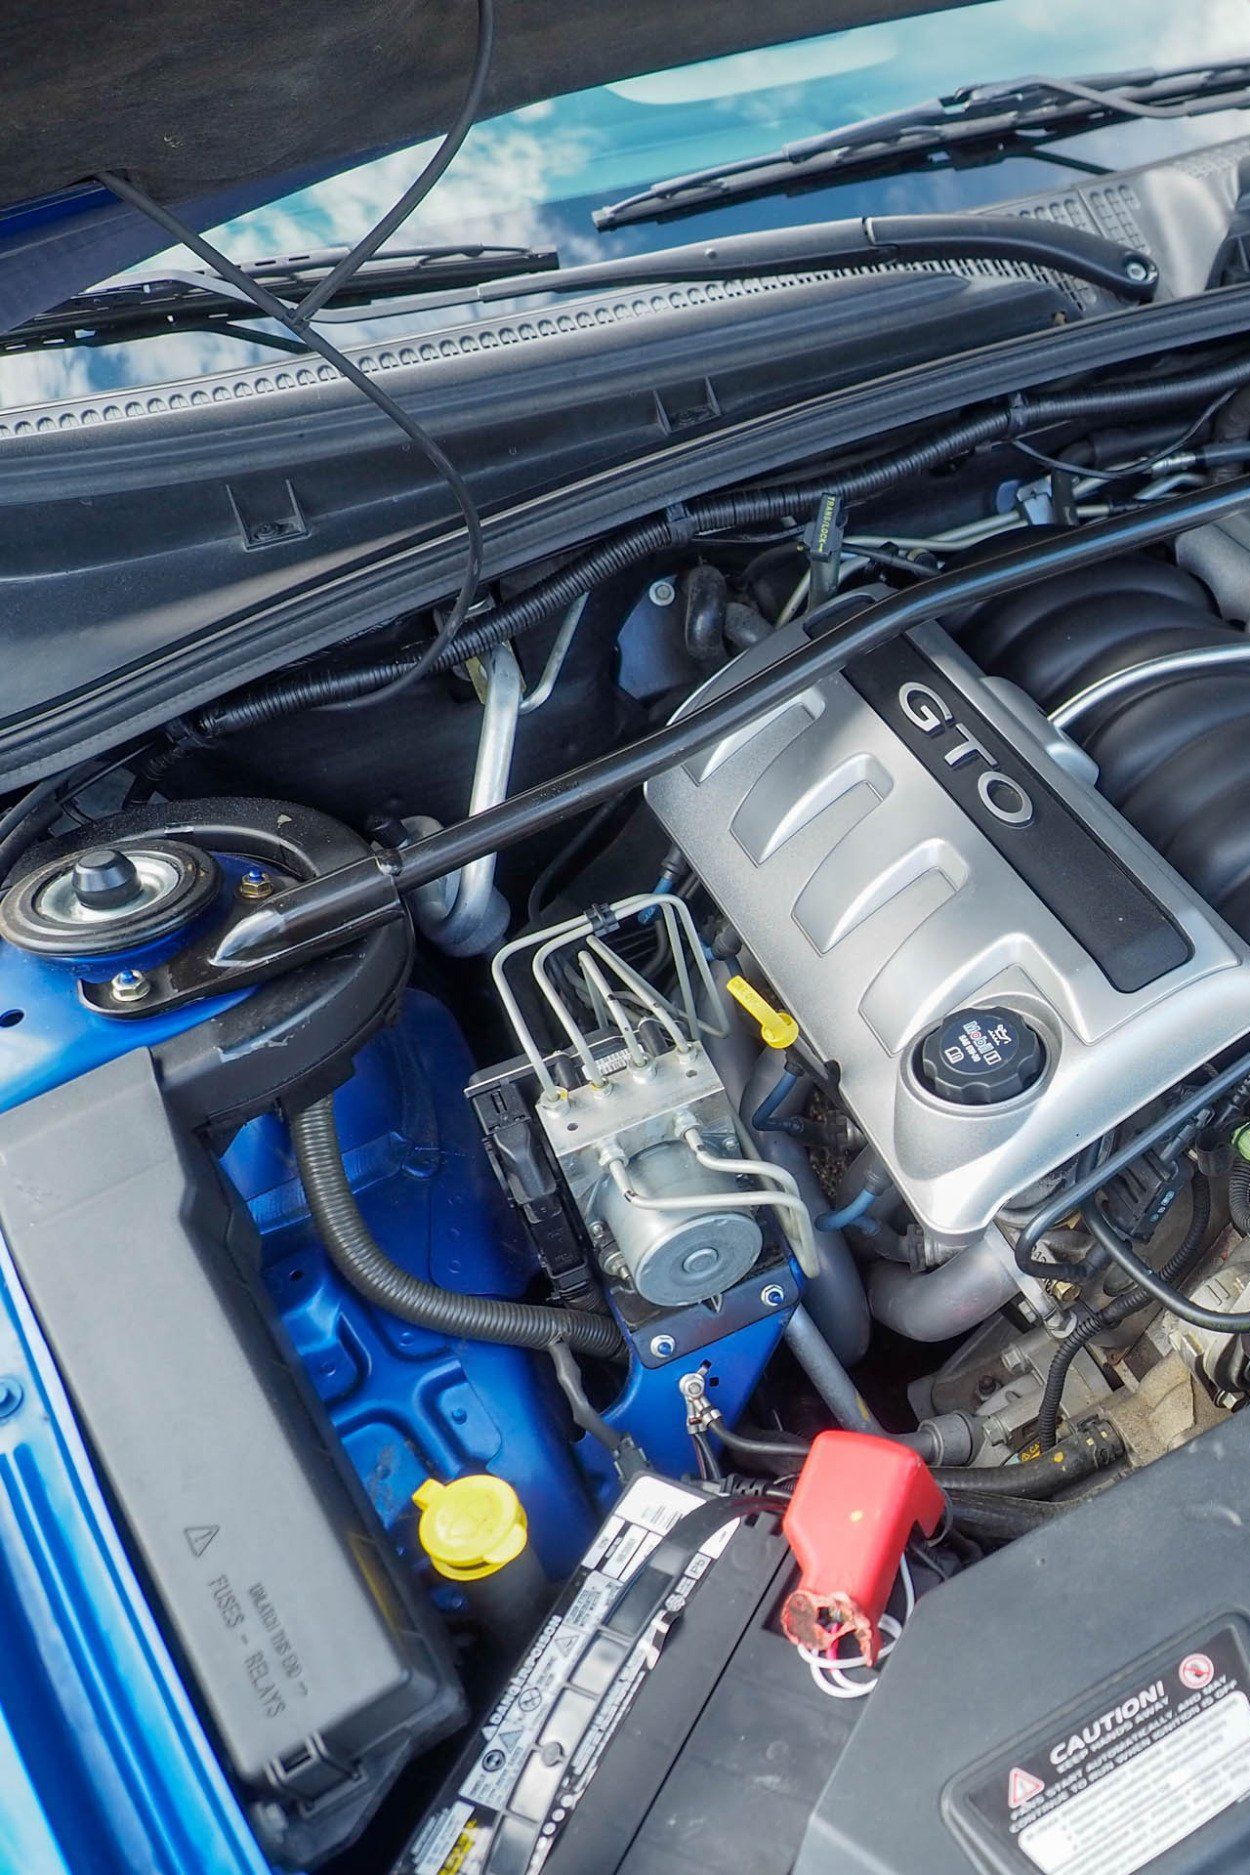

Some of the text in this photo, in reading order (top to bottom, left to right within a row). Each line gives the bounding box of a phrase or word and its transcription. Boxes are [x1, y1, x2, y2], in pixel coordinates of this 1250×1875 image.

[899, 682, 1033, 824] GTO
[962, 1019, 994, 1055] Mobil
[689, 1556, 706, 1575] Pb
[206, 1573, 245, 1629] FUSES
[243, 1649, 289, 1719] RELAYS
[1047, 1679, 1164, 1764] CAUTION!
[1132, 1694, 1172, 1725] AWAY
